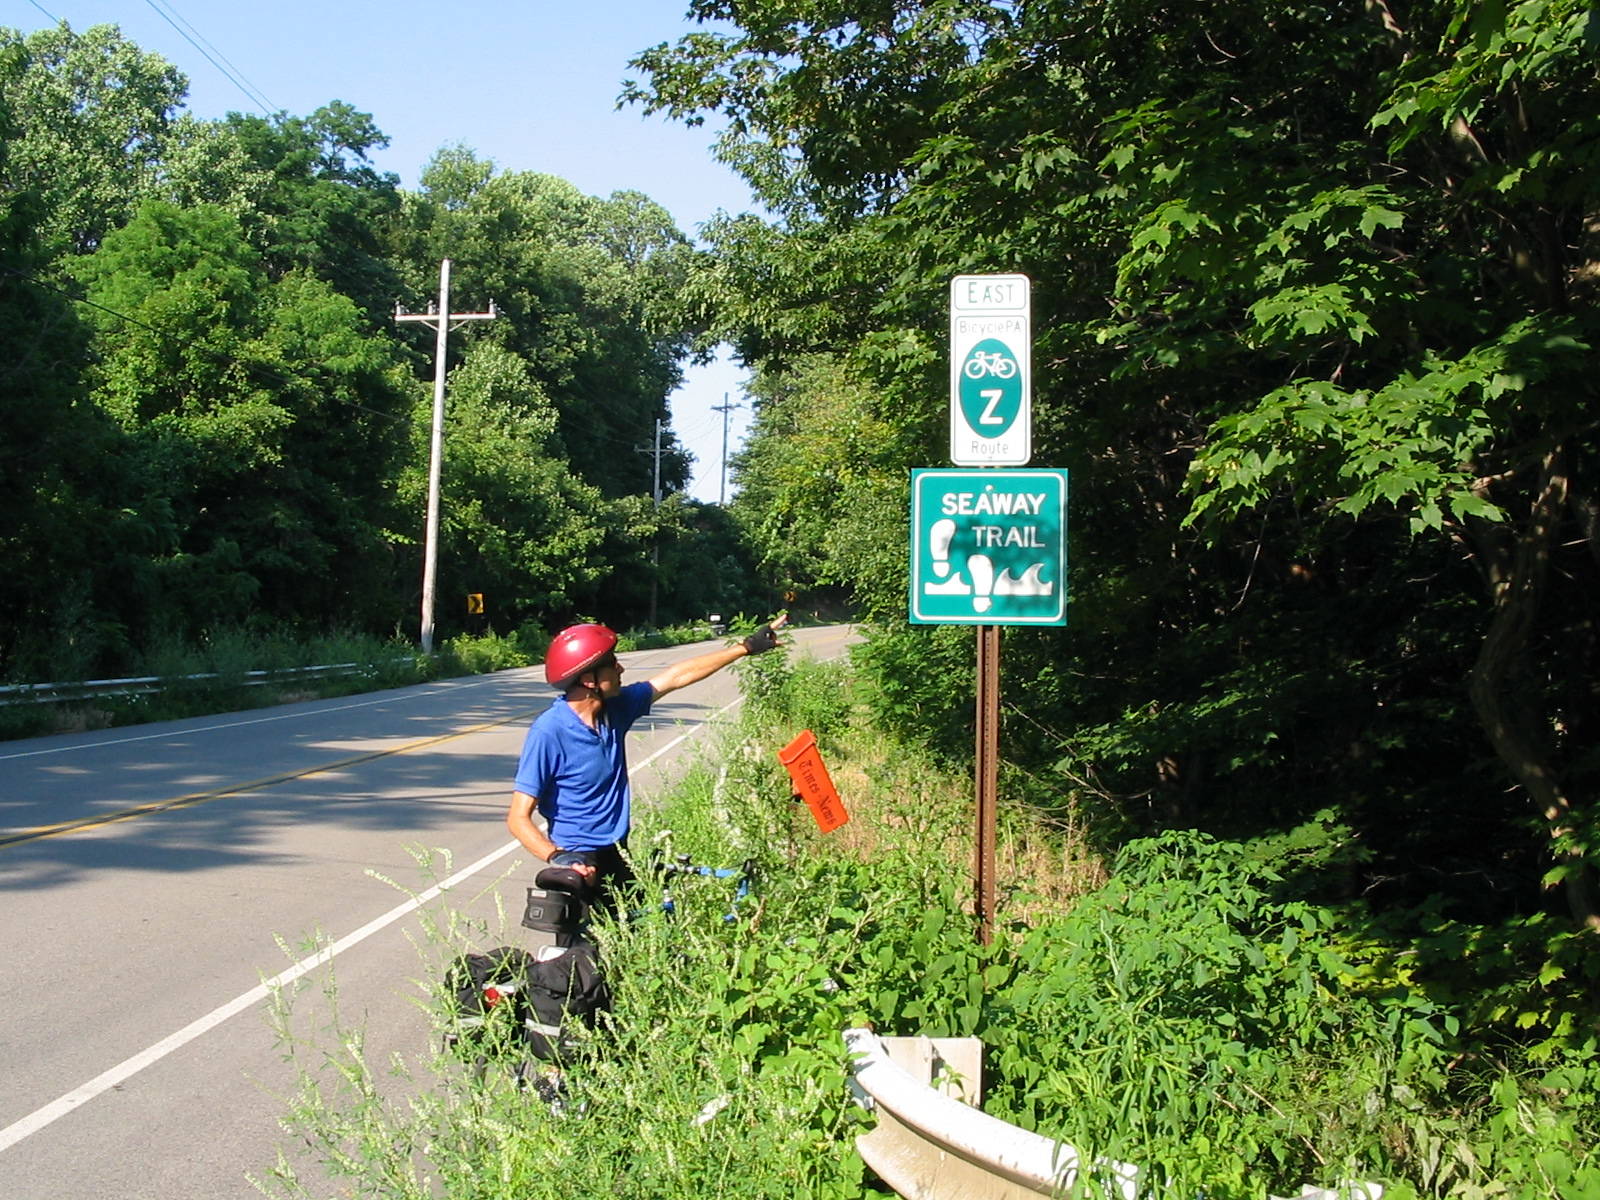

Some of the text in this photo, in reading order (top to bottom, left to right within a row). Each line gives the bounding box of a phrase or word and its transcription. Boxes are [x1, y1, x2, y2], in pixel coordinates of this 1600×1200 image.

[968, 281, 1014, 304] EAST
[959, 319, 1021, 335] BicyclePA
[979, 389, 1004, 425] Z
[971, 440, 1009, 455] Route
[941, 492, 1046, 515] SEAWAY
[971, 526, 1045, 547] TRAIL
